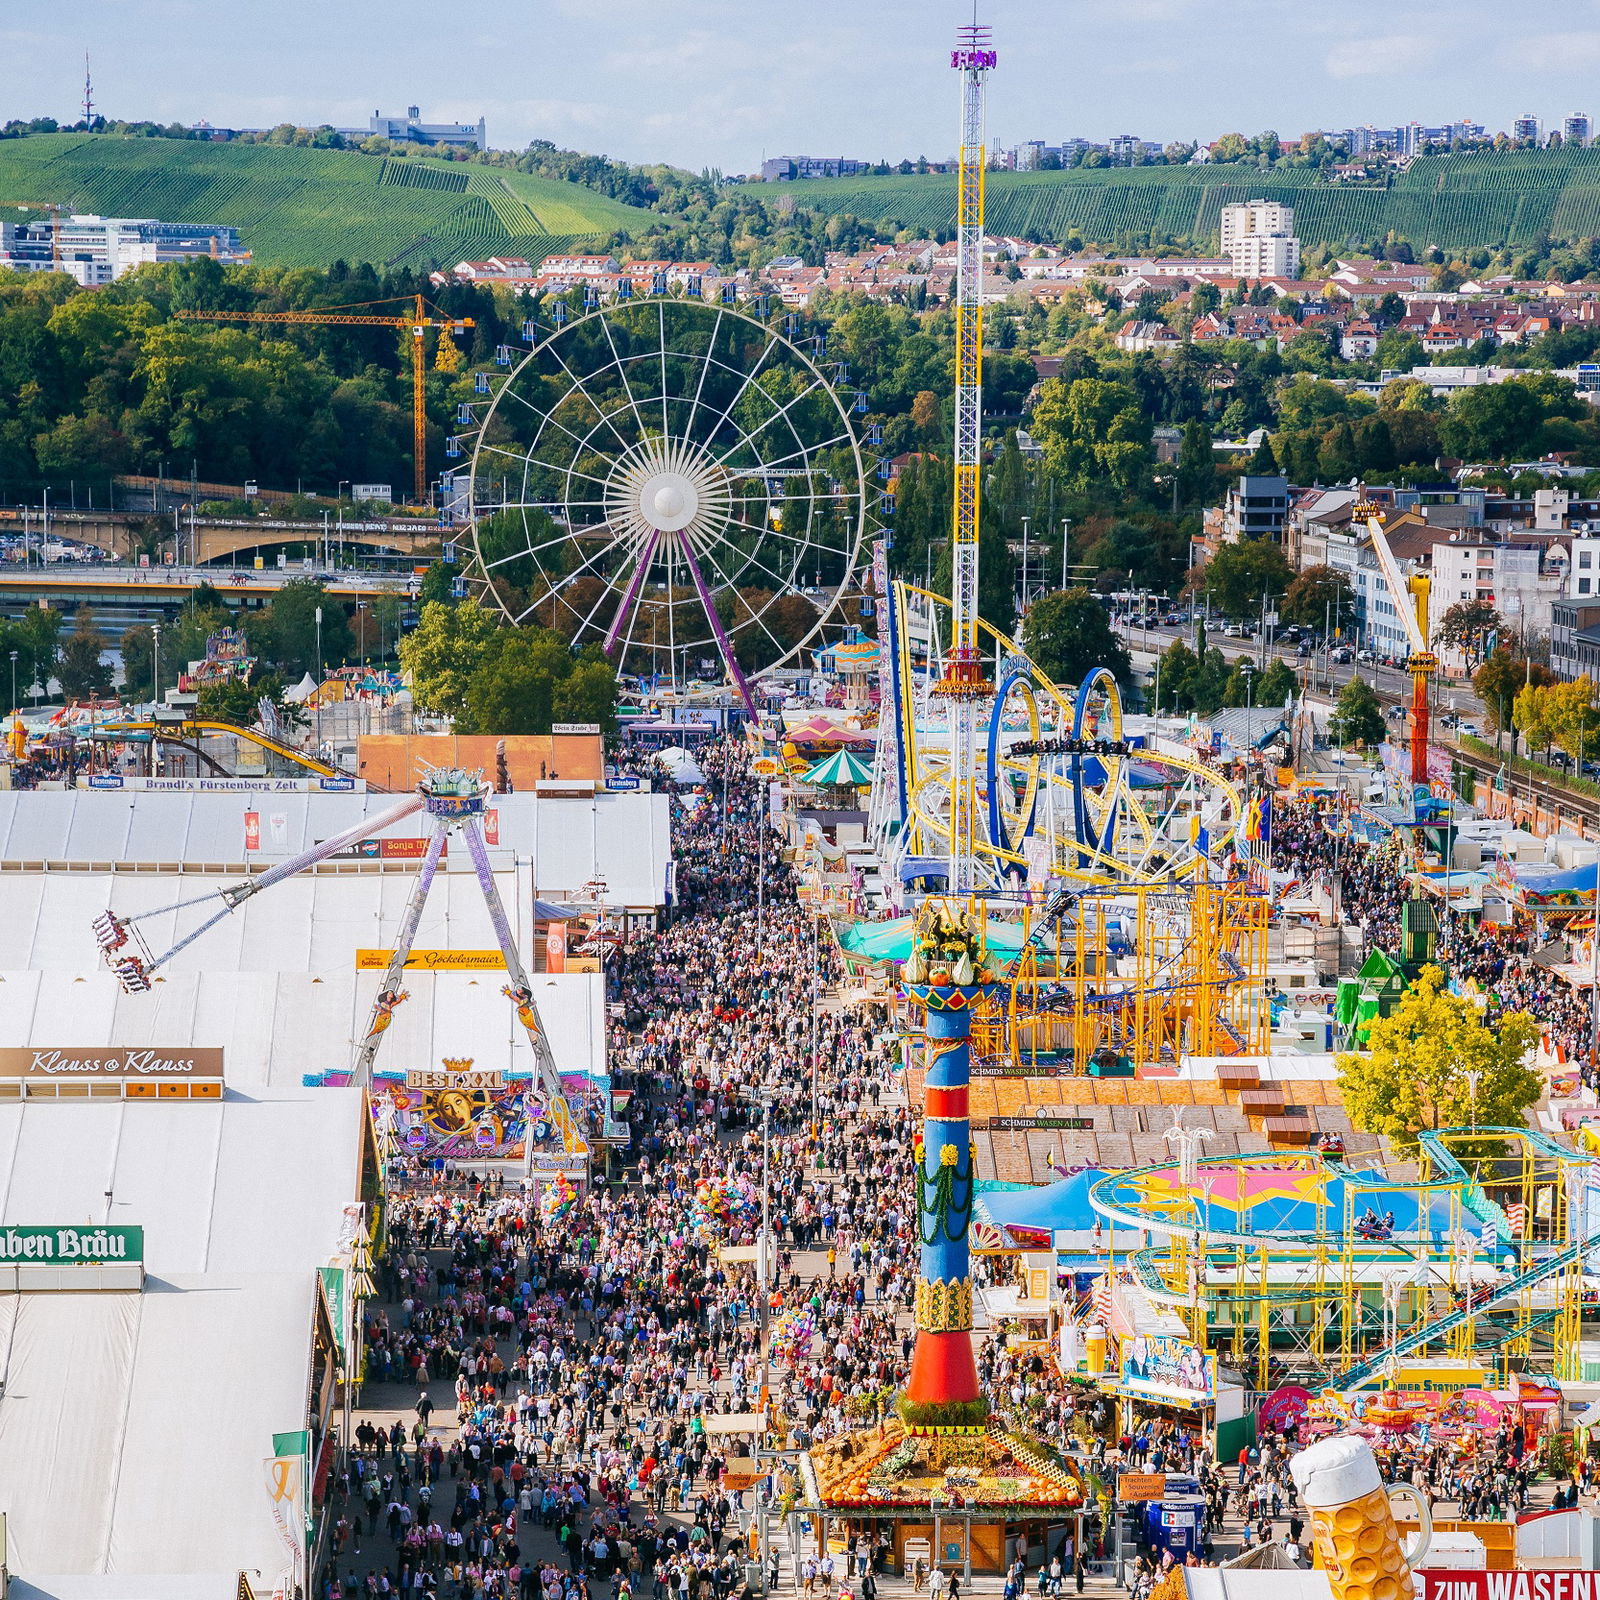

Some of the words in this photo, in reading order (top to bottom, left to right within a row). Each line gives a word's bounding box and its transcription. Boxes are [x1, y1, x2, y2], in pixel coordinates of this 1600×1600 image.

[92, 777, 120, 786] Fürstenberg
[146, 780, 193, 789] Brandl's
[200, 780, 270, 791] Fürstenberg
[275, 781, 298, 790] Zelt
[323, 780, 352, 788] Fürstenberg
[608, 779, 637, 788] Fürstenberg
[387, 841, 413, 850] Sonja
[424, 952, 504, 967] Göckelesmaier
[30, 1050, 100, 1074] Klauss
[123, 1050, 194, 1074] Klauss
[407, 1070, 457, 1087] BEST
[464, 1071, 506, 1088] XXL
[56, 1229, 126, 1258] Bräu
[1382, 1379, 1420, 1391] PWER
[1423, 1380, 1467, 1392] STATION
[1434, 1581, 1477, 1600] ZUM
[1486, 1572, 1600, 1600] WASEN
